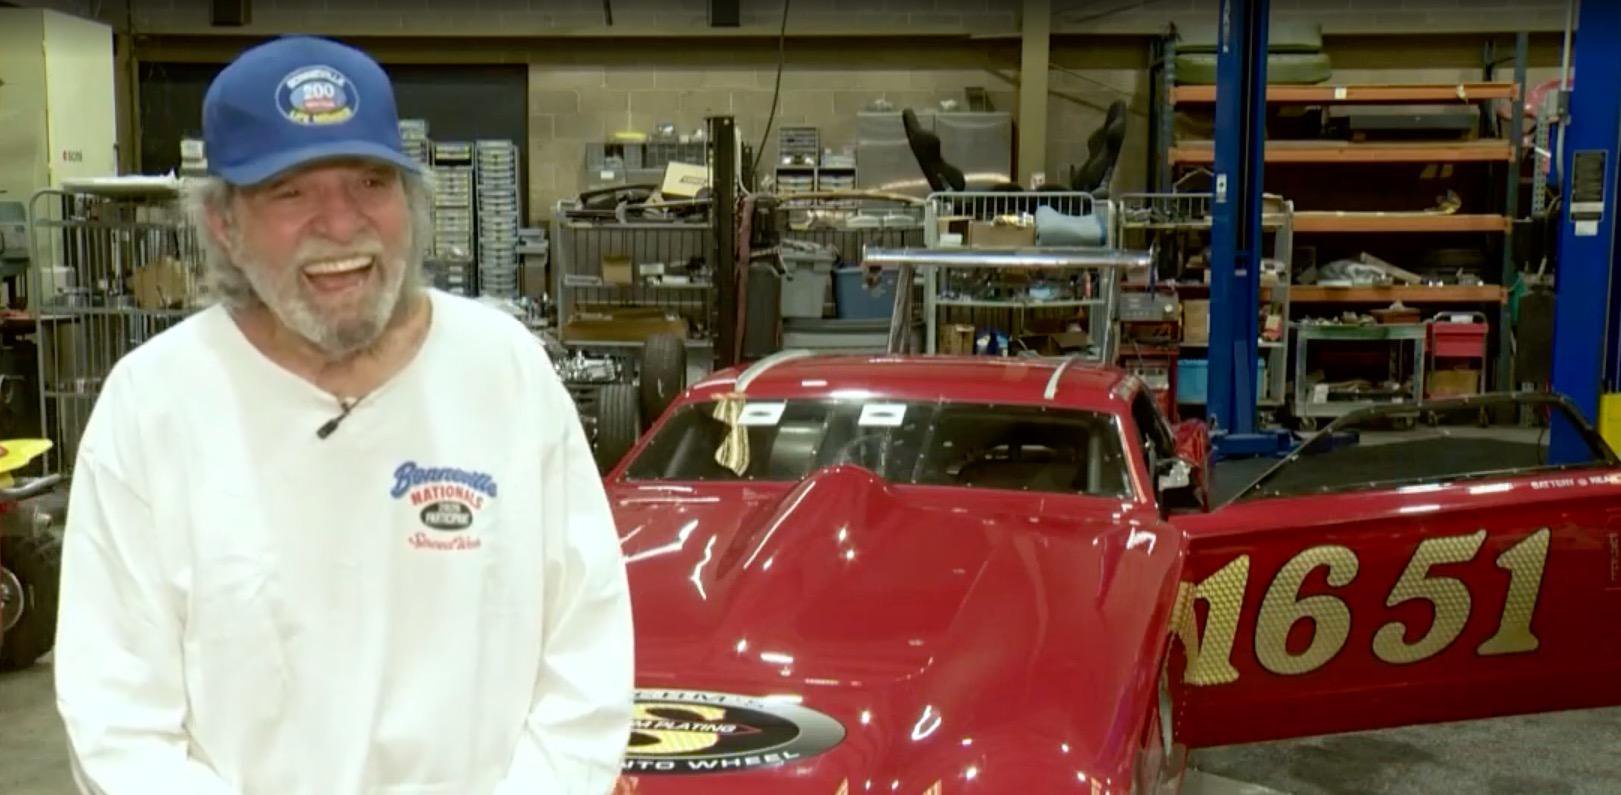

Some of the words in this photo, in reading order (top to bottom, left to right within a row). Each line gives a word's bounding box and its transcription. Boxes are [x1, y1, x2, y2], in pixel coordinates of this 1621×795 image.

[303, 82, 336, 100] 200
[1529, 479, 1575, 490] BATTERY
[410, 485, 484, 510] NATIONALS
[1183, 527, 1551, 686] 1651
[654, 720, 737, 733] PLATING
[620, 759, 675, 770] UTO
[687, 751, 800, 770] WHEEL
